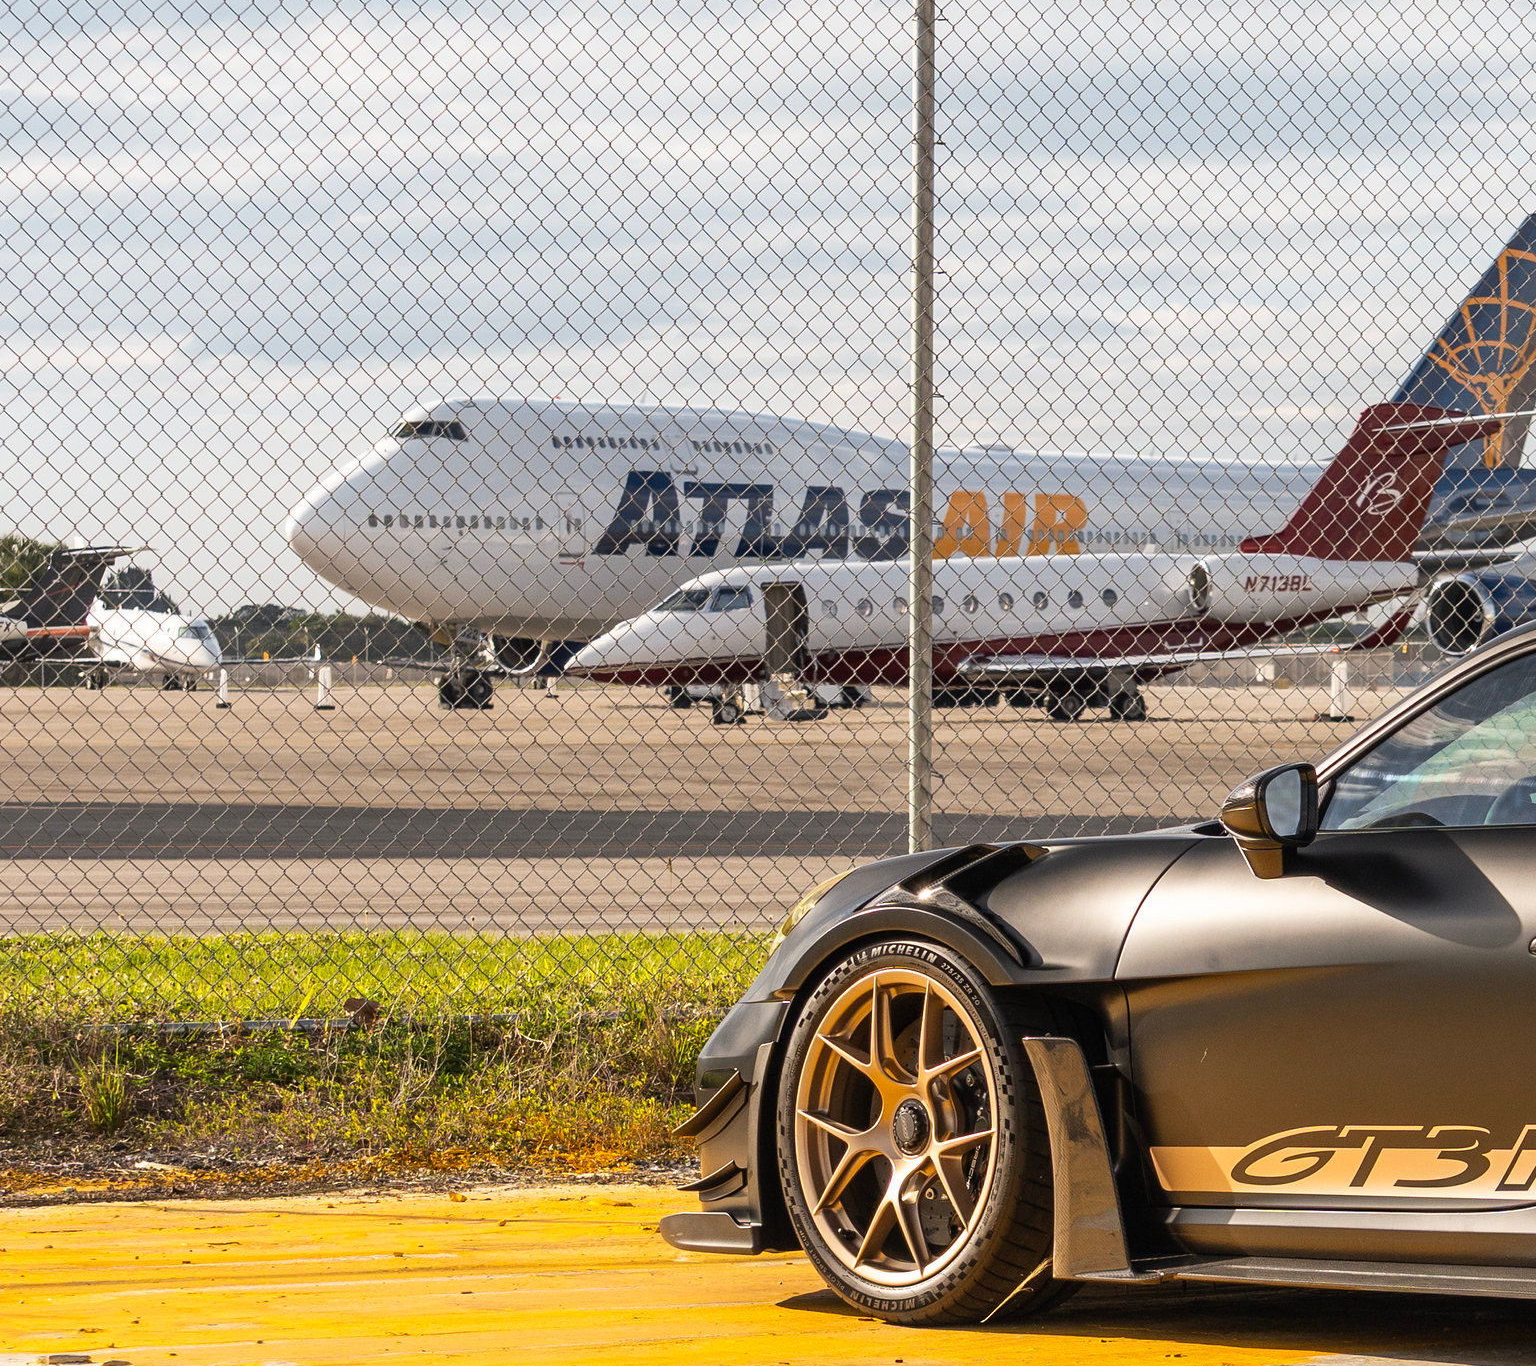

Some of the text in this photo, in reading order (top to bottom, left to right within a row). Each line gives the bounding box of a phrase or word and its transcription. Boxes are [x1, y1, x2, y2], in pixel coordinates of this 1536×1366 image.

[592, 471, 1089, 563] ATLAS AIR
[871, 944, 938, 964] MICHELIN
[963, 983, 973, 995] ZR
[849, 1290, 916, 1312] MICHELIN
